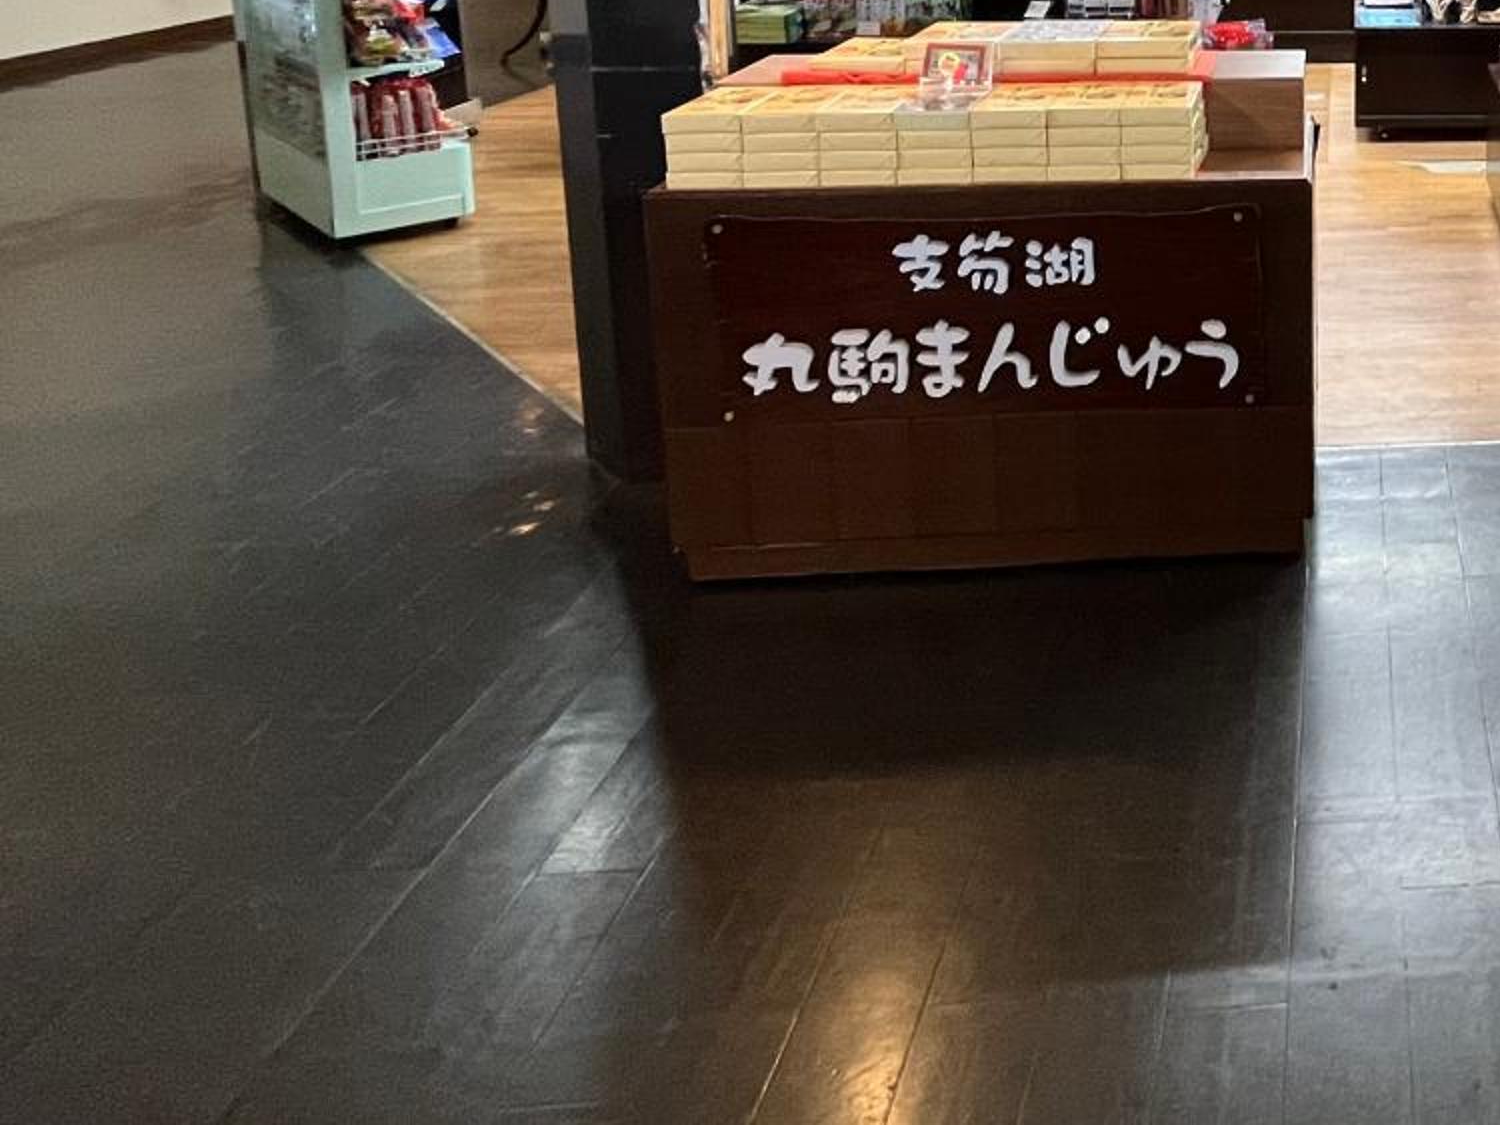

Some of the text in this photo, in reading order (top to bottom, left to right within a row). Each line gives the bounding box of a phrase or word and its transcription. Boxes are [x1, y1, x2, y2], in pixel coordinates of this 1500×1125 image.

[891, 230, 1096, 295] 支笏湖
[742, 318, 1240, 403] 丸駒まんじゅう
